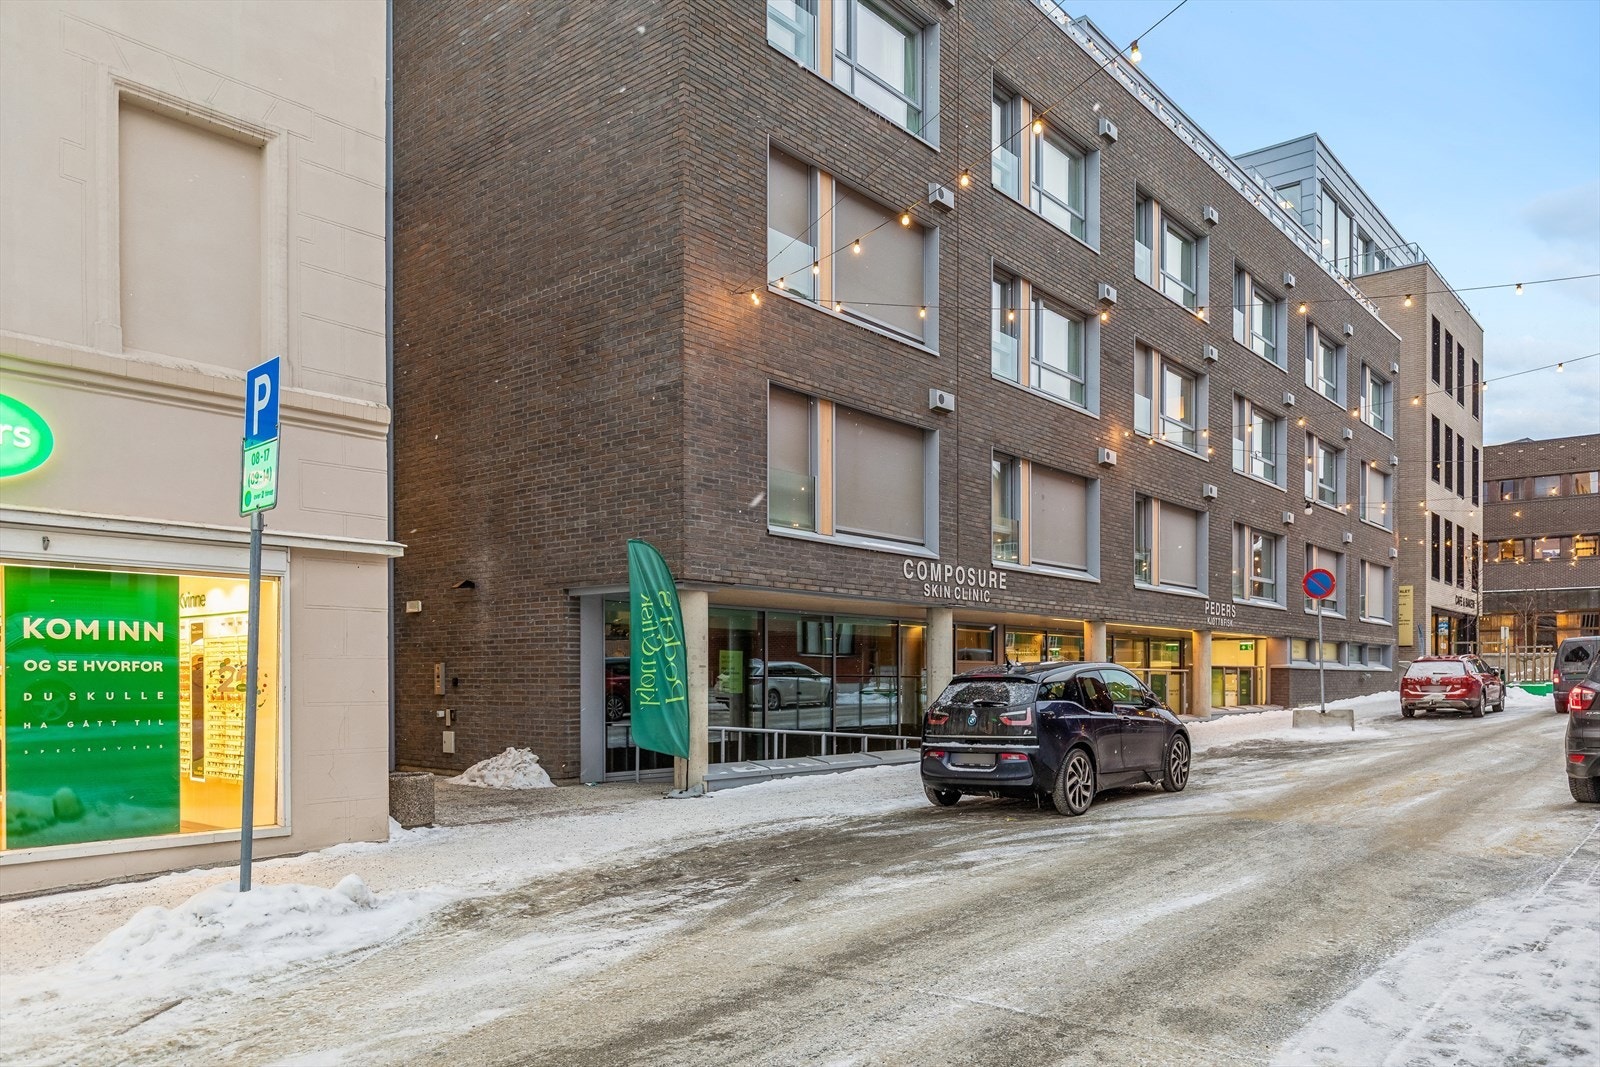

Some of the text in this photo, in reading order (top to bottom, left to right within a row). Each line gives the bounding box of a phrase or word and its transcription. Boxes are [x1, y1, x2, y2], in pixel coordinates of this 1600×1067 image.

[252, 373, 272, 436] P
[903, 559, 1007, 590] COMPOSURE
[923, 583, 991, 603] SKIN CLINIC
[1205, 600, 1237, 618] PEDERS
[23, 617, 164, 642] KOM INN
[23, 659, 164, 672] OG SE HVORFOR
[23, 691, 164, 702] DU SKULLE
[23, 719, 164, 730] HA GÅTT TIL
